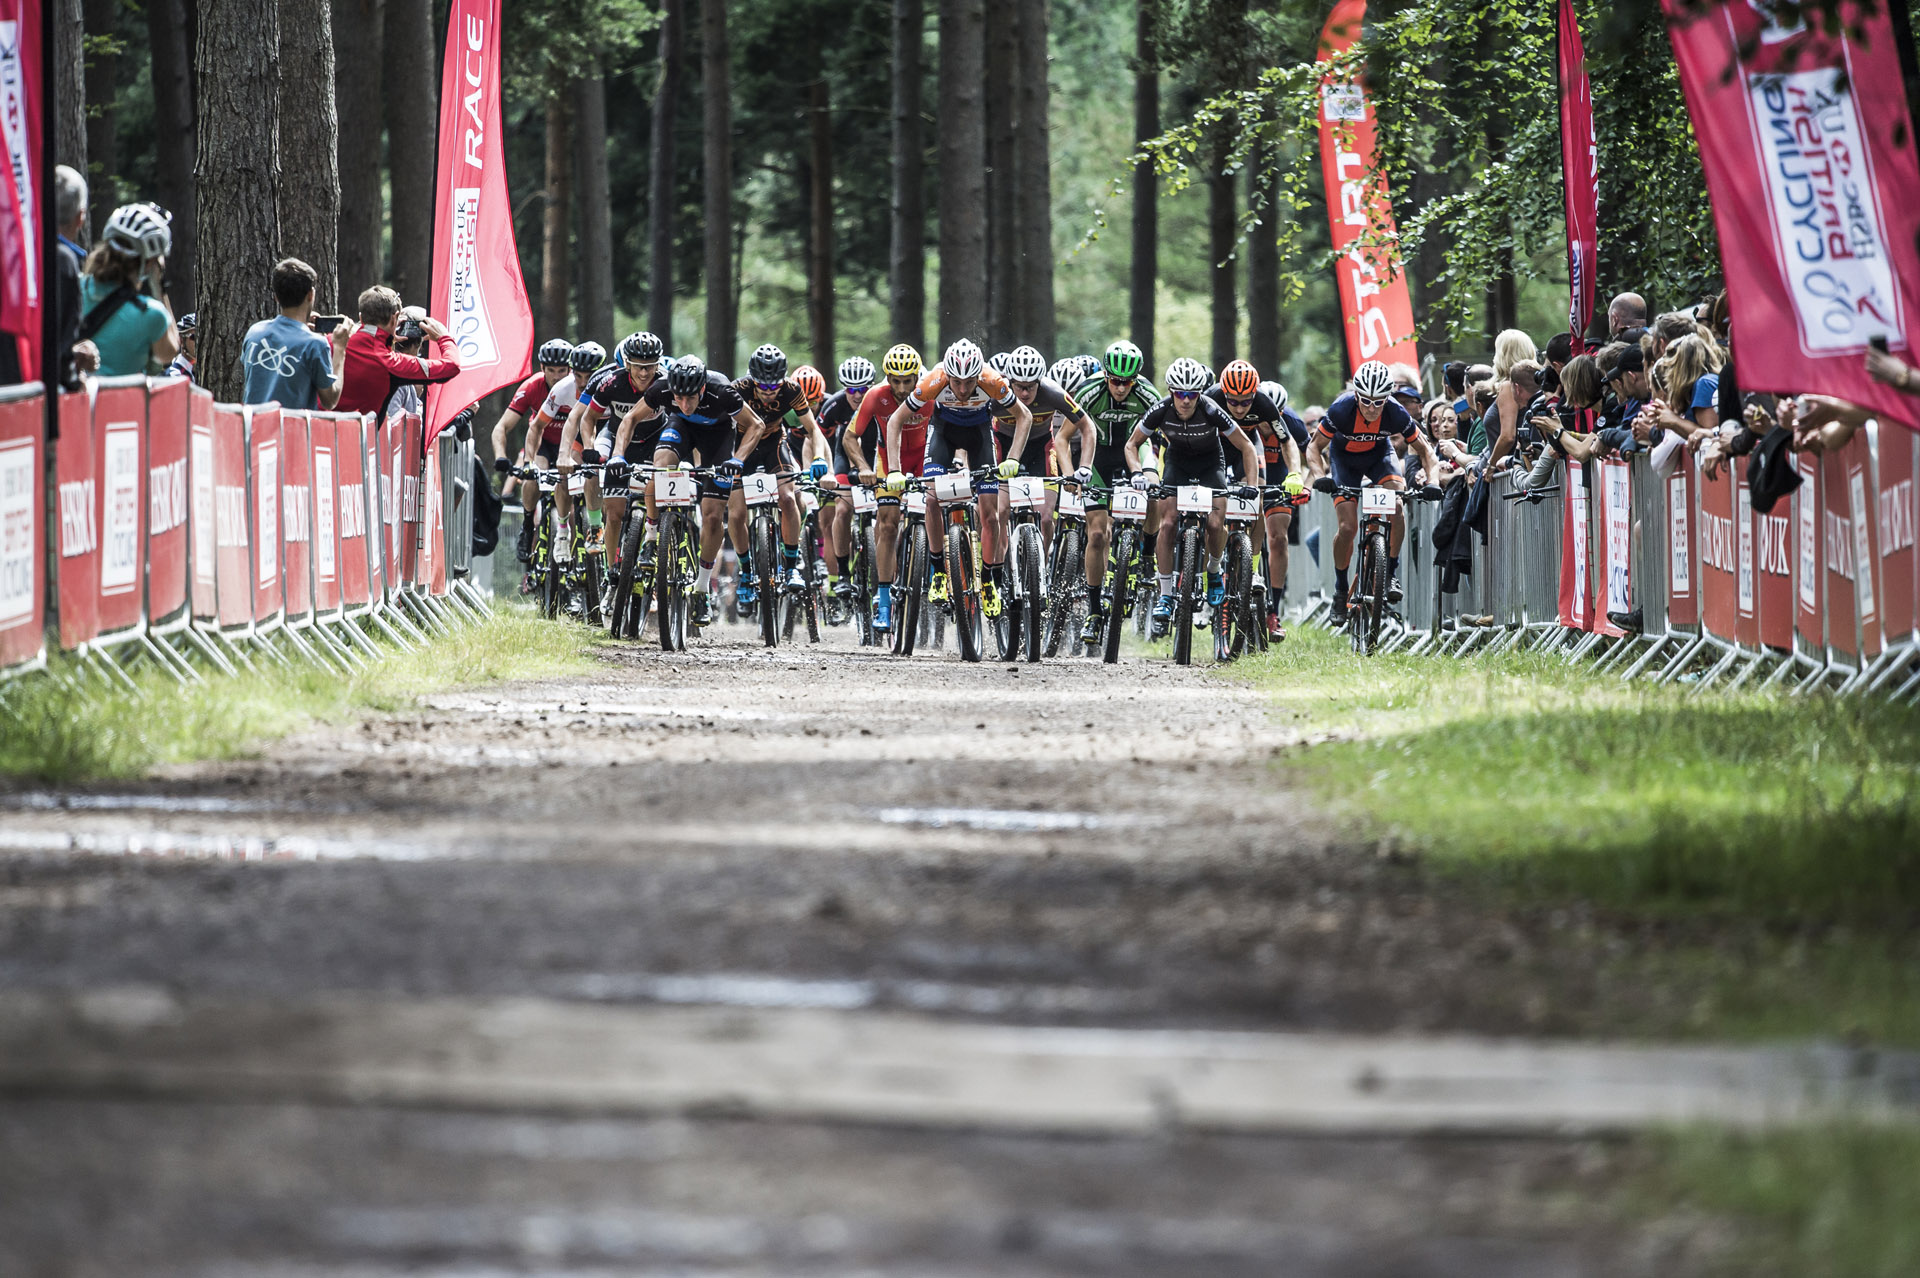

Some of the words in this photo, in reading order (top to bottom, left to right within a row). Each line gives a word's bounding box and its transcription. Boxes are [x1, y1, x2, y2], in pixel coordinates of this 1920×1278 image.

[465, 13, 484, 170] RACE
[457, 202, 466, 229] UK
[1334, 138, 1394, 359] START
[454, 260, 464, 312] HSBC
[668, 481, 677, 497] 2
[756, 478, 764, 493] 9
[950, 482, 957, 497] 1
[1022, 483, 1030, 497] 3
[1123, 495, 1138, 509] 10
[1191, 491, 1199, 503] 4
[1372, 494, 1387, 506] 12
[1721, 517, 1734, 573] UK
[1768, 516, 1790, 576] UK
